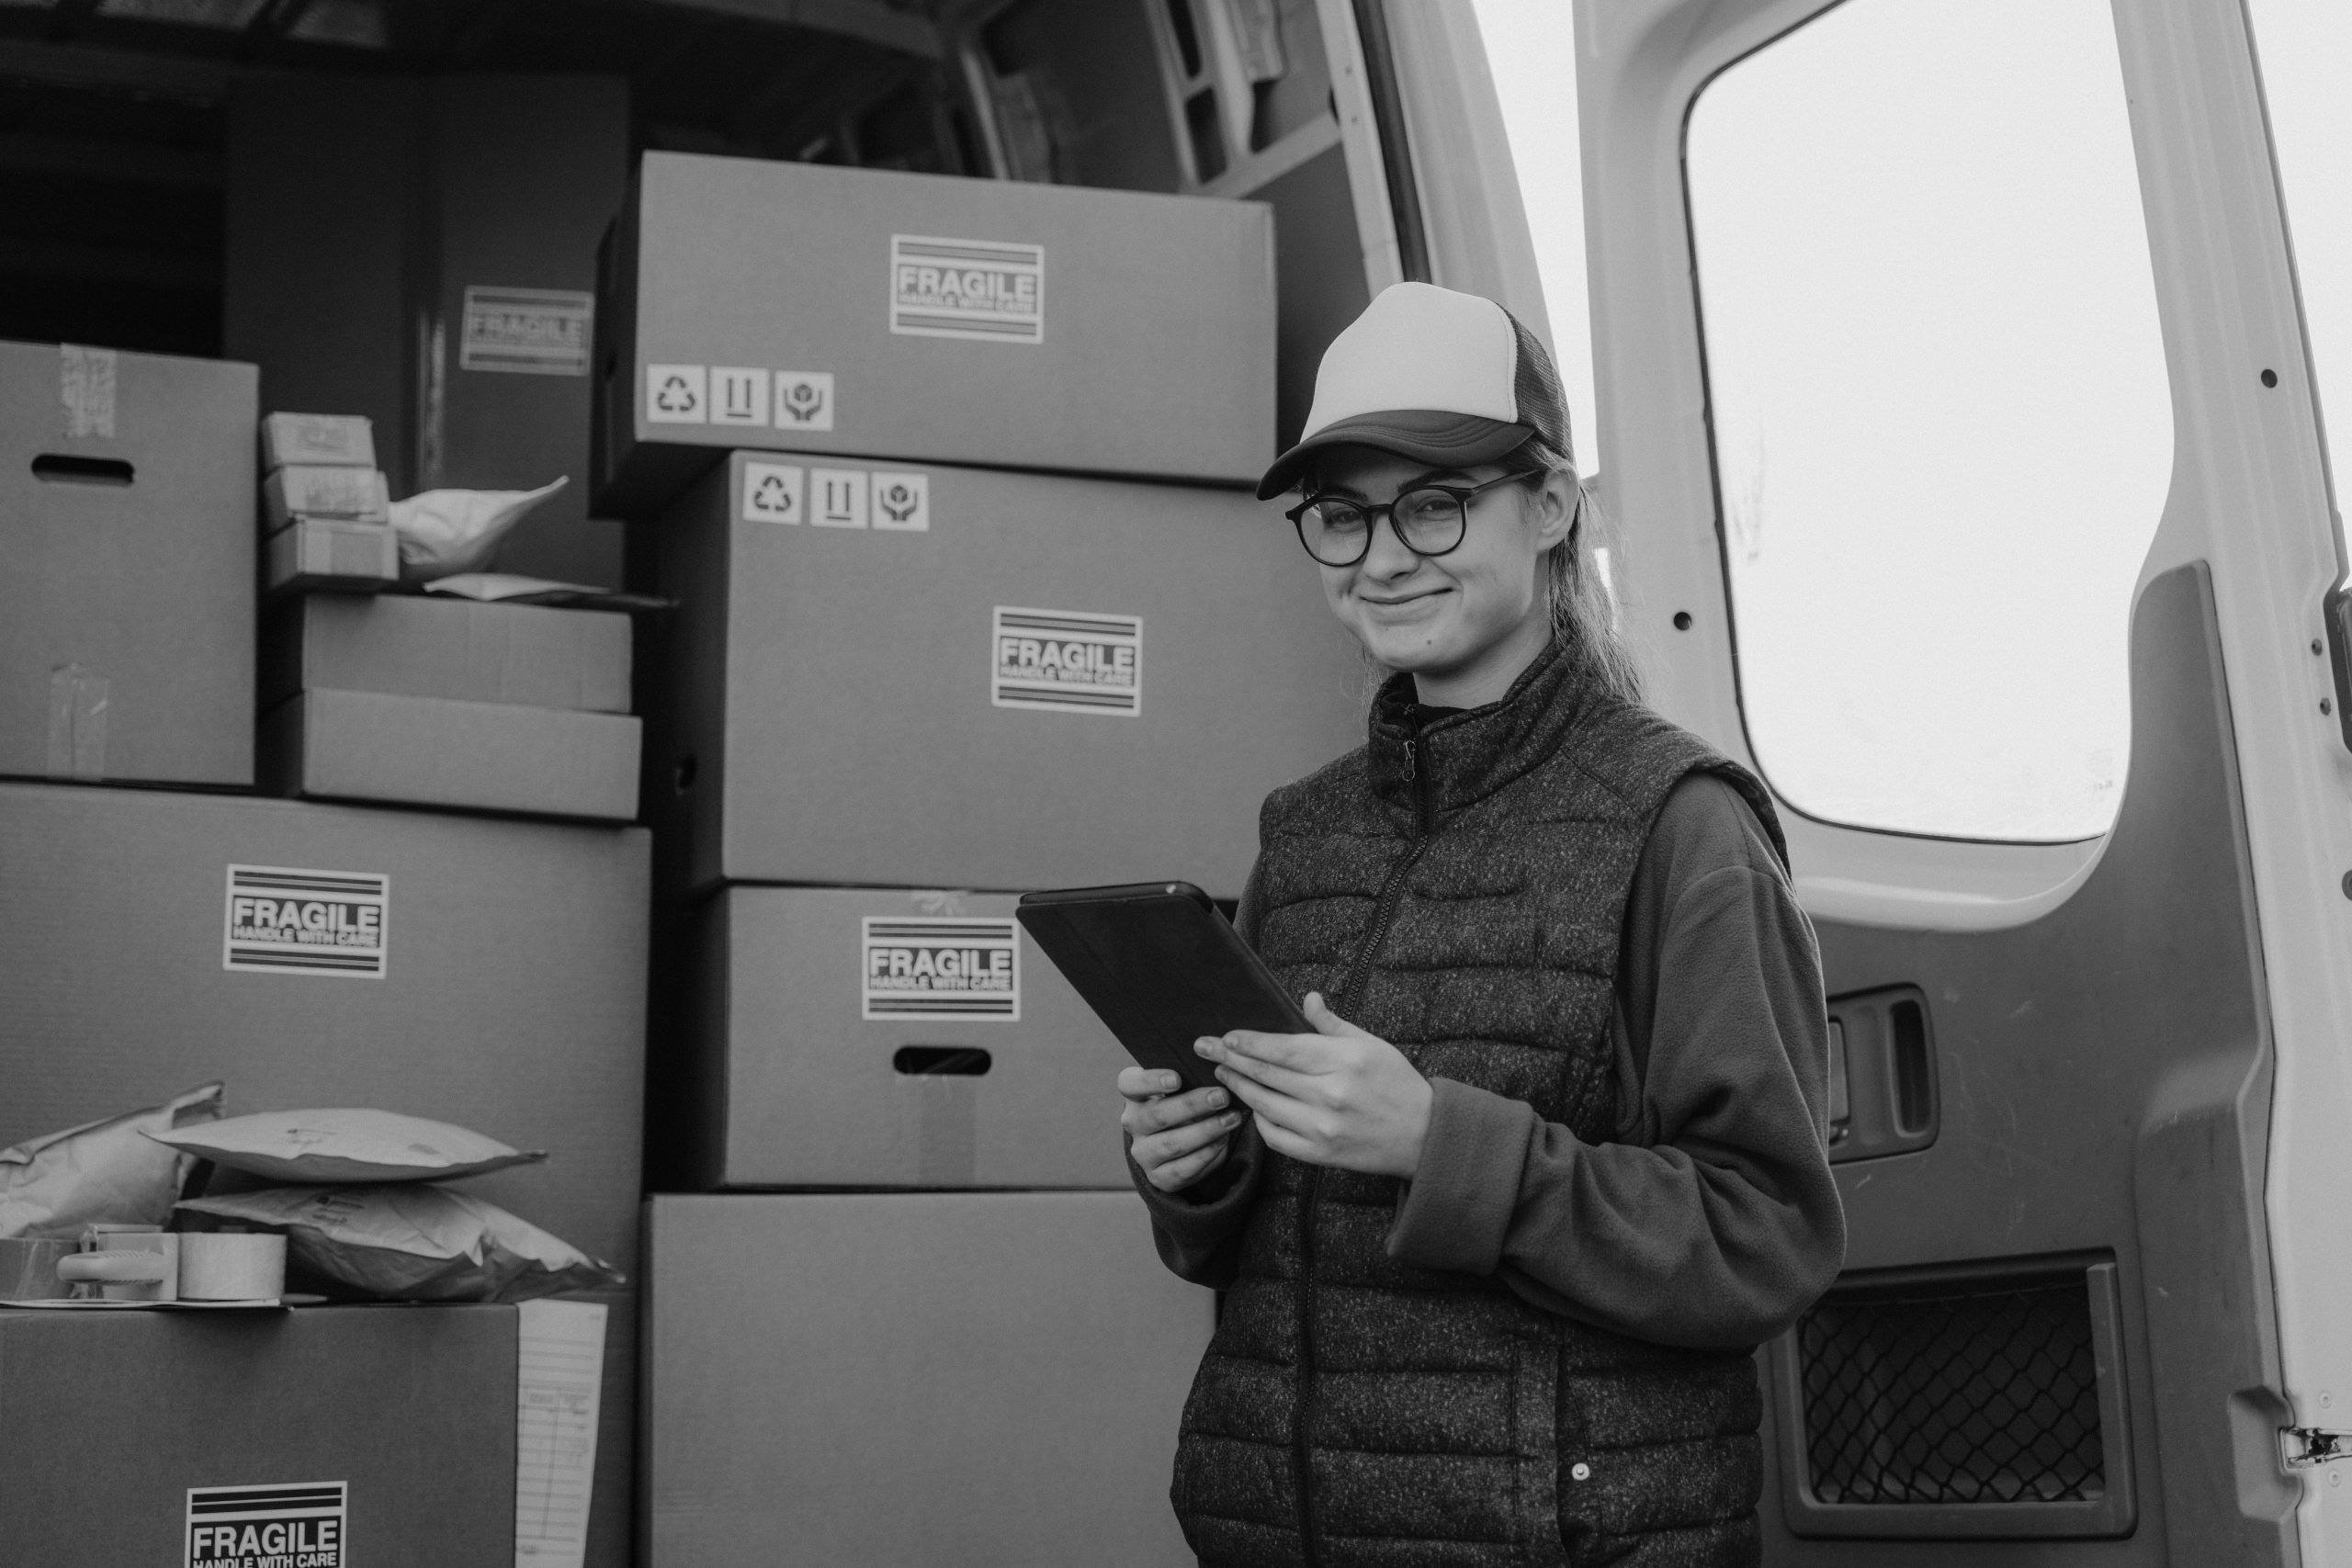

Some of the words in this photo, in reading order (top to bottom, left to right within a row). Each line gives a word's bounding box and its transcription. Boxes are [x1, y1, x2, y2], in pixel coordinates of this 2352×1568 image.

[898, 265, 1037, 303] FRAGILE
[1000, 637, 1135, 673] FRAGILE
[232, 897, 380, 933] FRAGILE
[870, 948, 1012, 978] FRAGILE
[193, 1519, 338, 1560] FRAGILE
[193, 1556, 254, 1568] HANDLE
[256, 1554, 294, 1568] WITH
[296, 1551, 337, 1567] CARE
